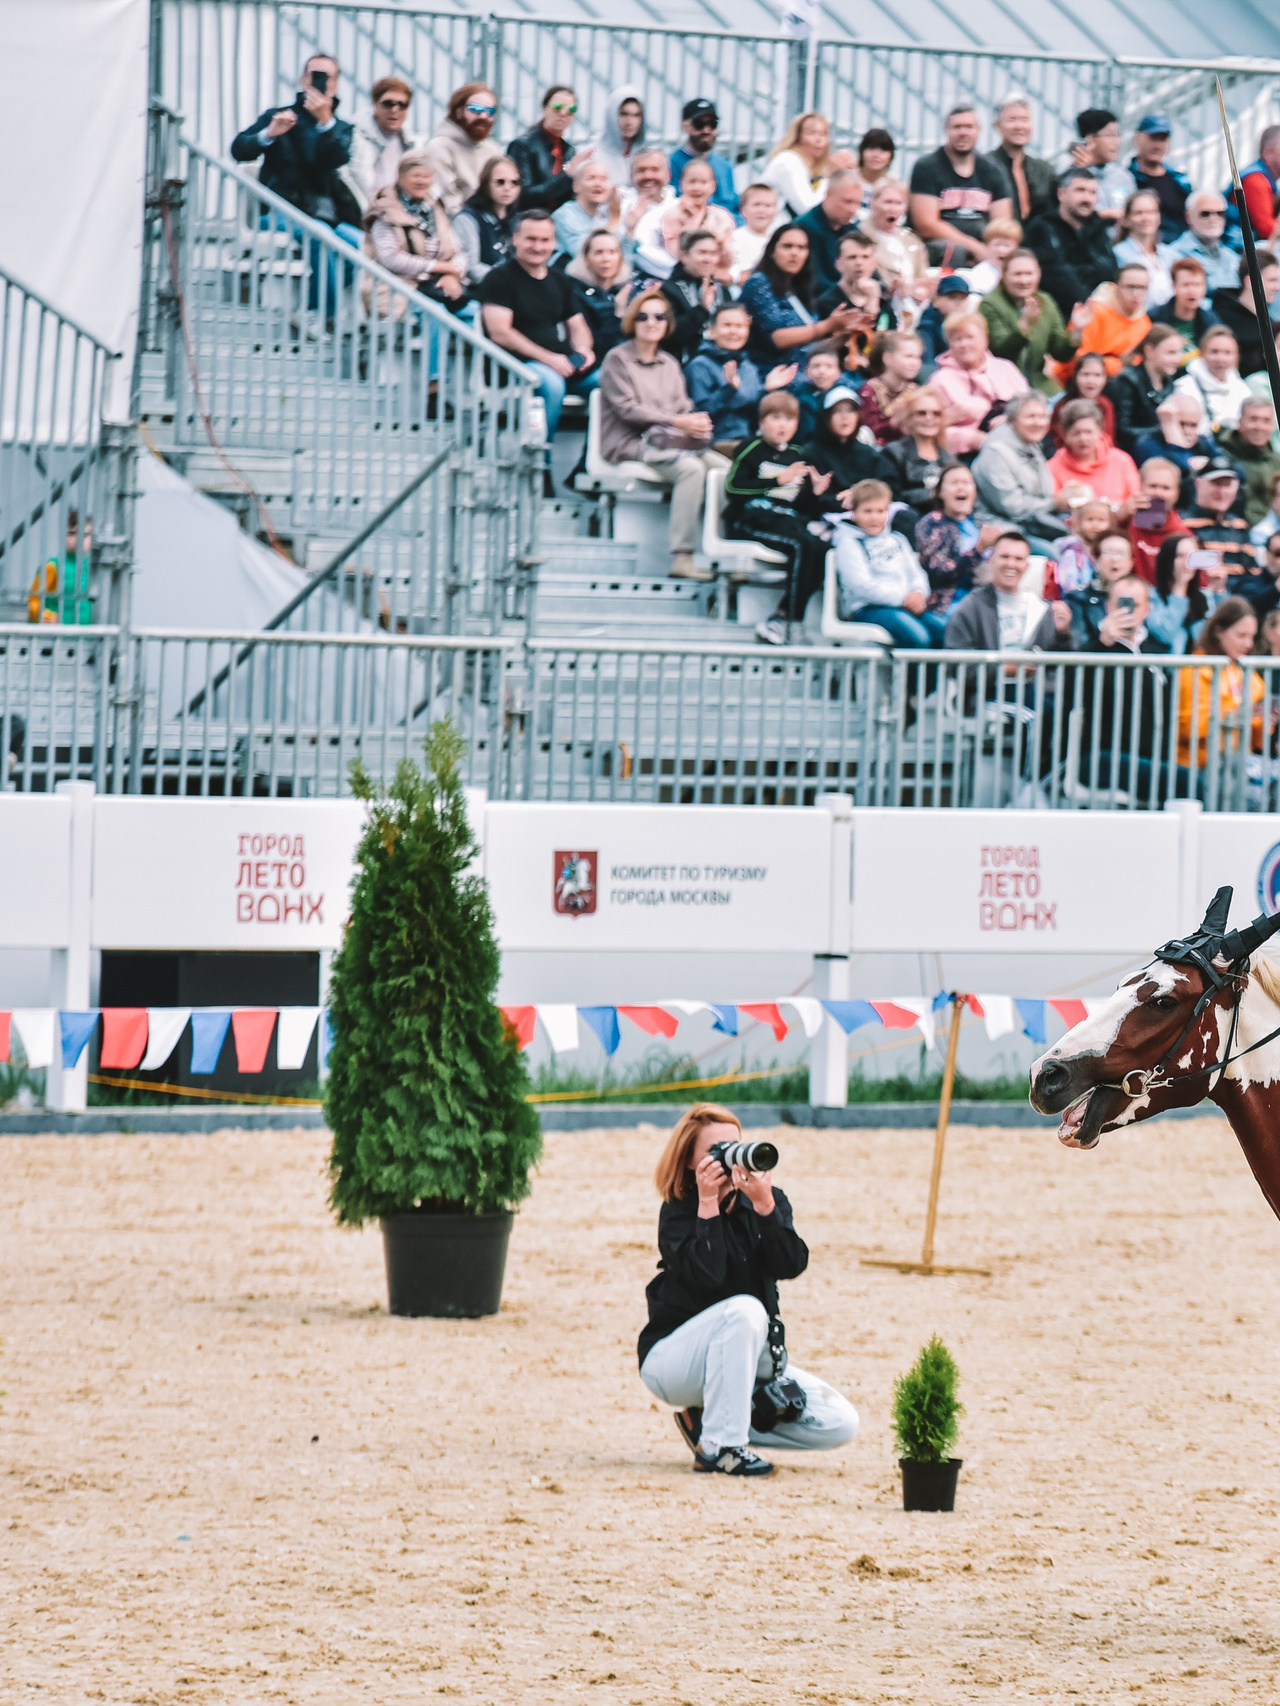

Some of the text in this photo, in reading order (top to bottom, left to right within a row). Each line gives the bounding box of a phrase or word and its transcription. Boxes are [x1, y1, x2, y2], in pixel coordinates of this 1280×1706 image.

[238, 834, 304, 857] ГОРОД
[980, 847, 1039, 868] ГОРОД
[236, 861, 305, 889] ЛЕТО
[610, 865, 768, 882] КОМИТЕТ ПО ТУРИЗМУ
[979, 872, 1041, 898] ЛЕТО
[237, 892, 324, 923] ВДНХ
[610, 889, 731, 906] ГОРОДА МОСКВЫ
[980, 901, 1057, 931] ВДНХ
